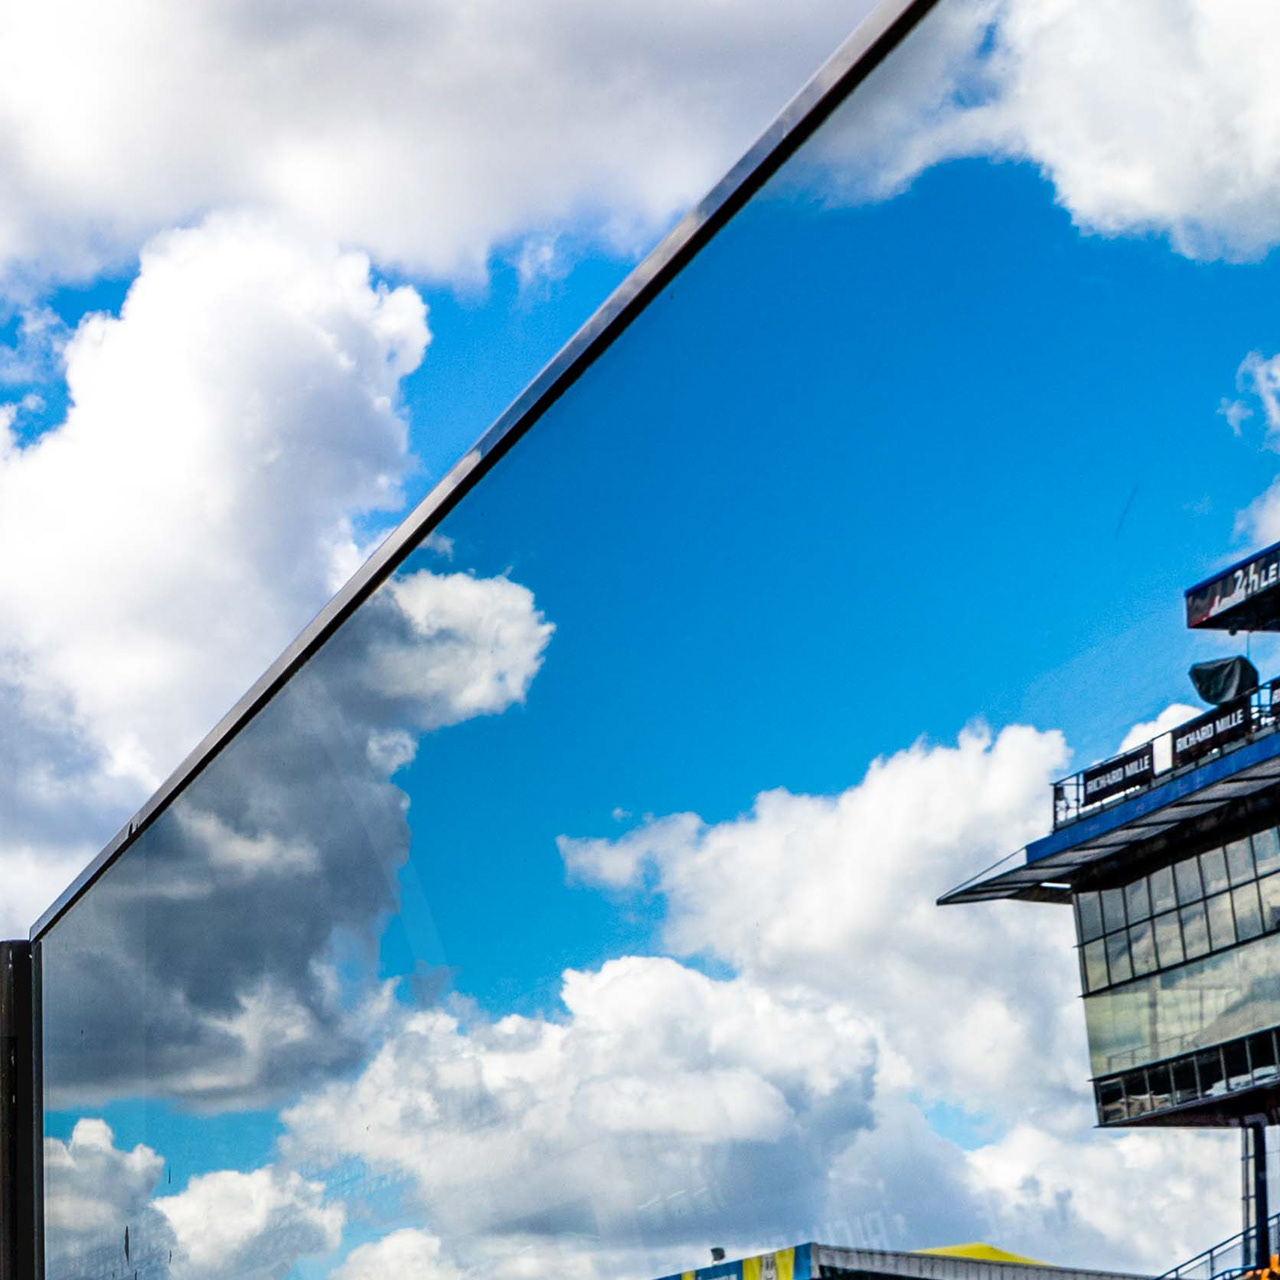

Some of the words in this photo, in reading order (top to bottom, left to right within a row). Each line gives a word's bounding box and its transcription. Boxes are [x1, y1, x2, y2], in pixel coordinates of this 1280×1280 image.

[1176, 724, 1213, 752] RICHARD
[1215, 709, 1243, 733] MILLE
[1125, 755, 1150, 777] MILLE
